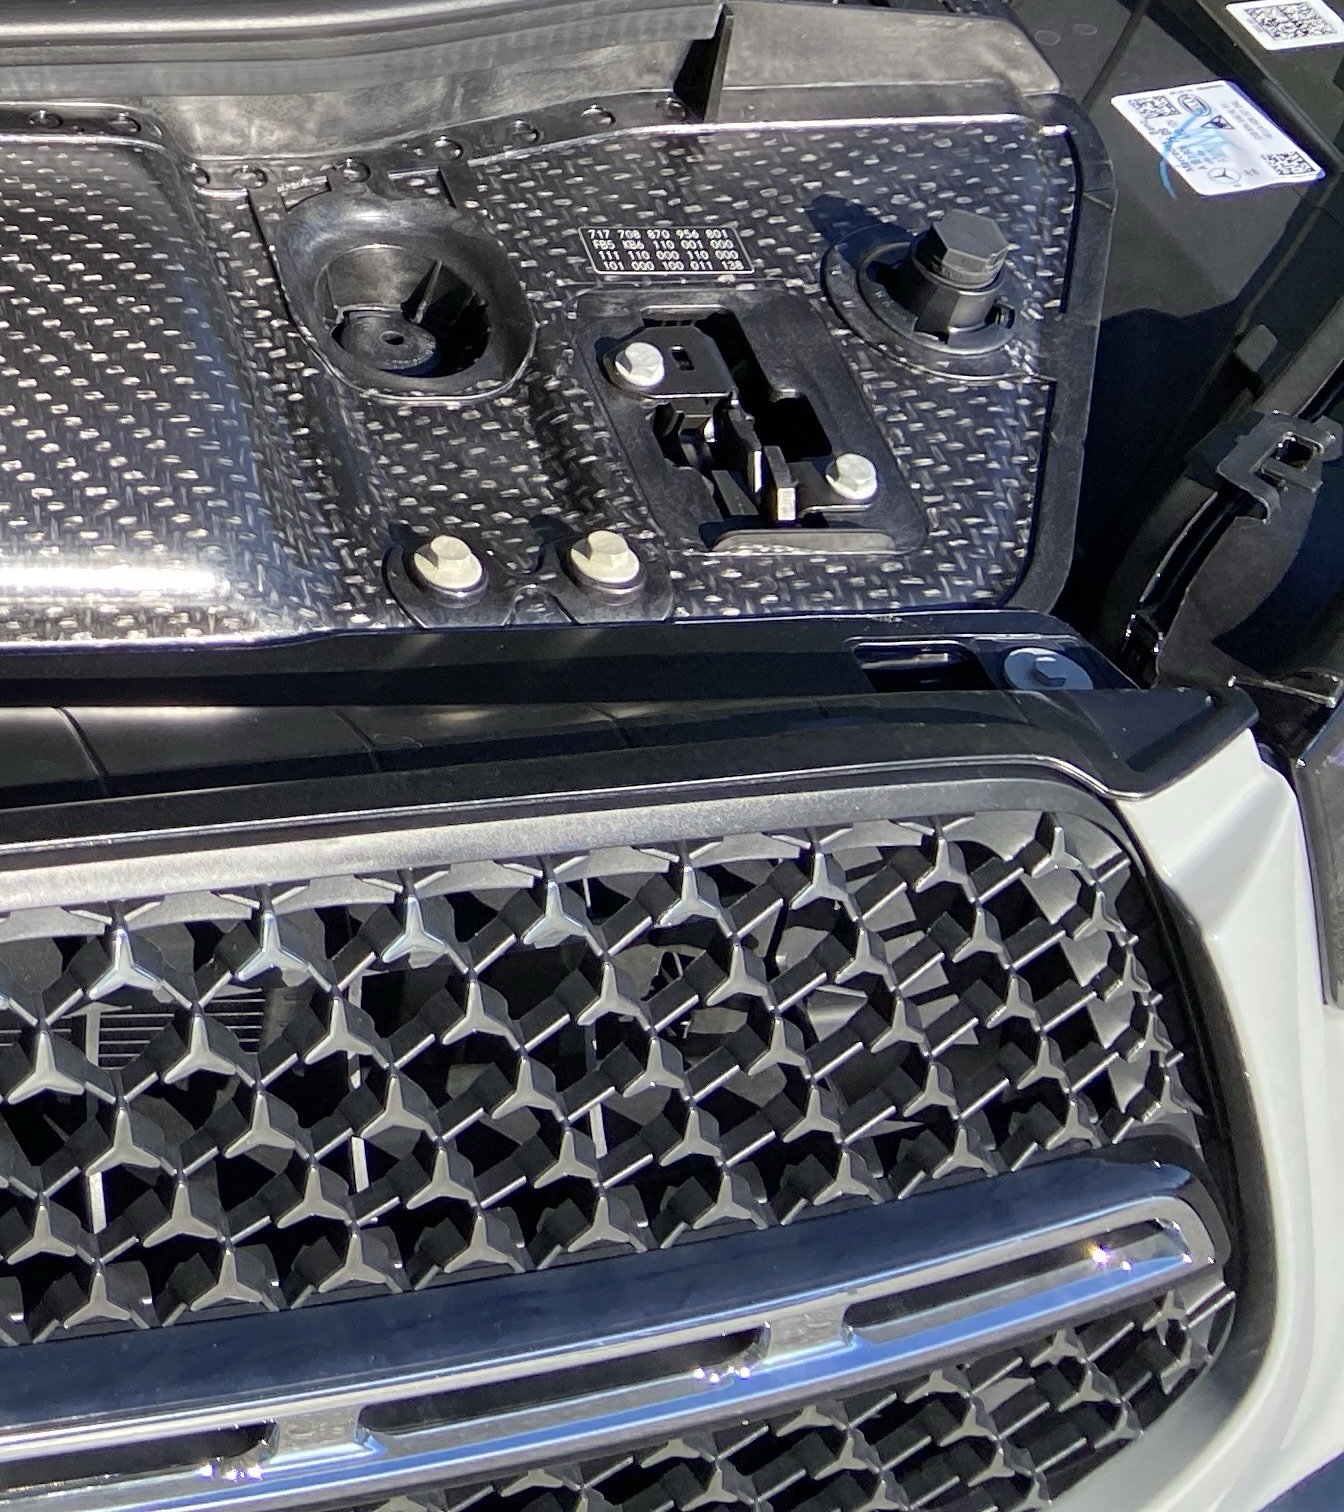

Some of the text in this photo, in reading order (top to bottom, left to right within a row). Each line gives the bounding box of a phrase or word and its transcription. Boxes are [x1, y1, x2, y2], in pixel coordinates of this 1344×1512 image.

[587, 229, 610, 239] 717
[647, 229, 670, 239] 870
[676, 229, 699, 239] 956
[706, 229, 728, 239] 801
[592, 240, 616, 249] FB5
[653, 240, 675, 249] 110
[681, 240, 703, 249] 001
[710, 240, 734, 249] 000
[599, 250, 738, 260] 111 110 000 110 000
[603, 261, 624, 270] 101
[631, 261, 655, 270] 000
[662, 261, 684, 270] 100
[690, 261, 713, 270] 011
